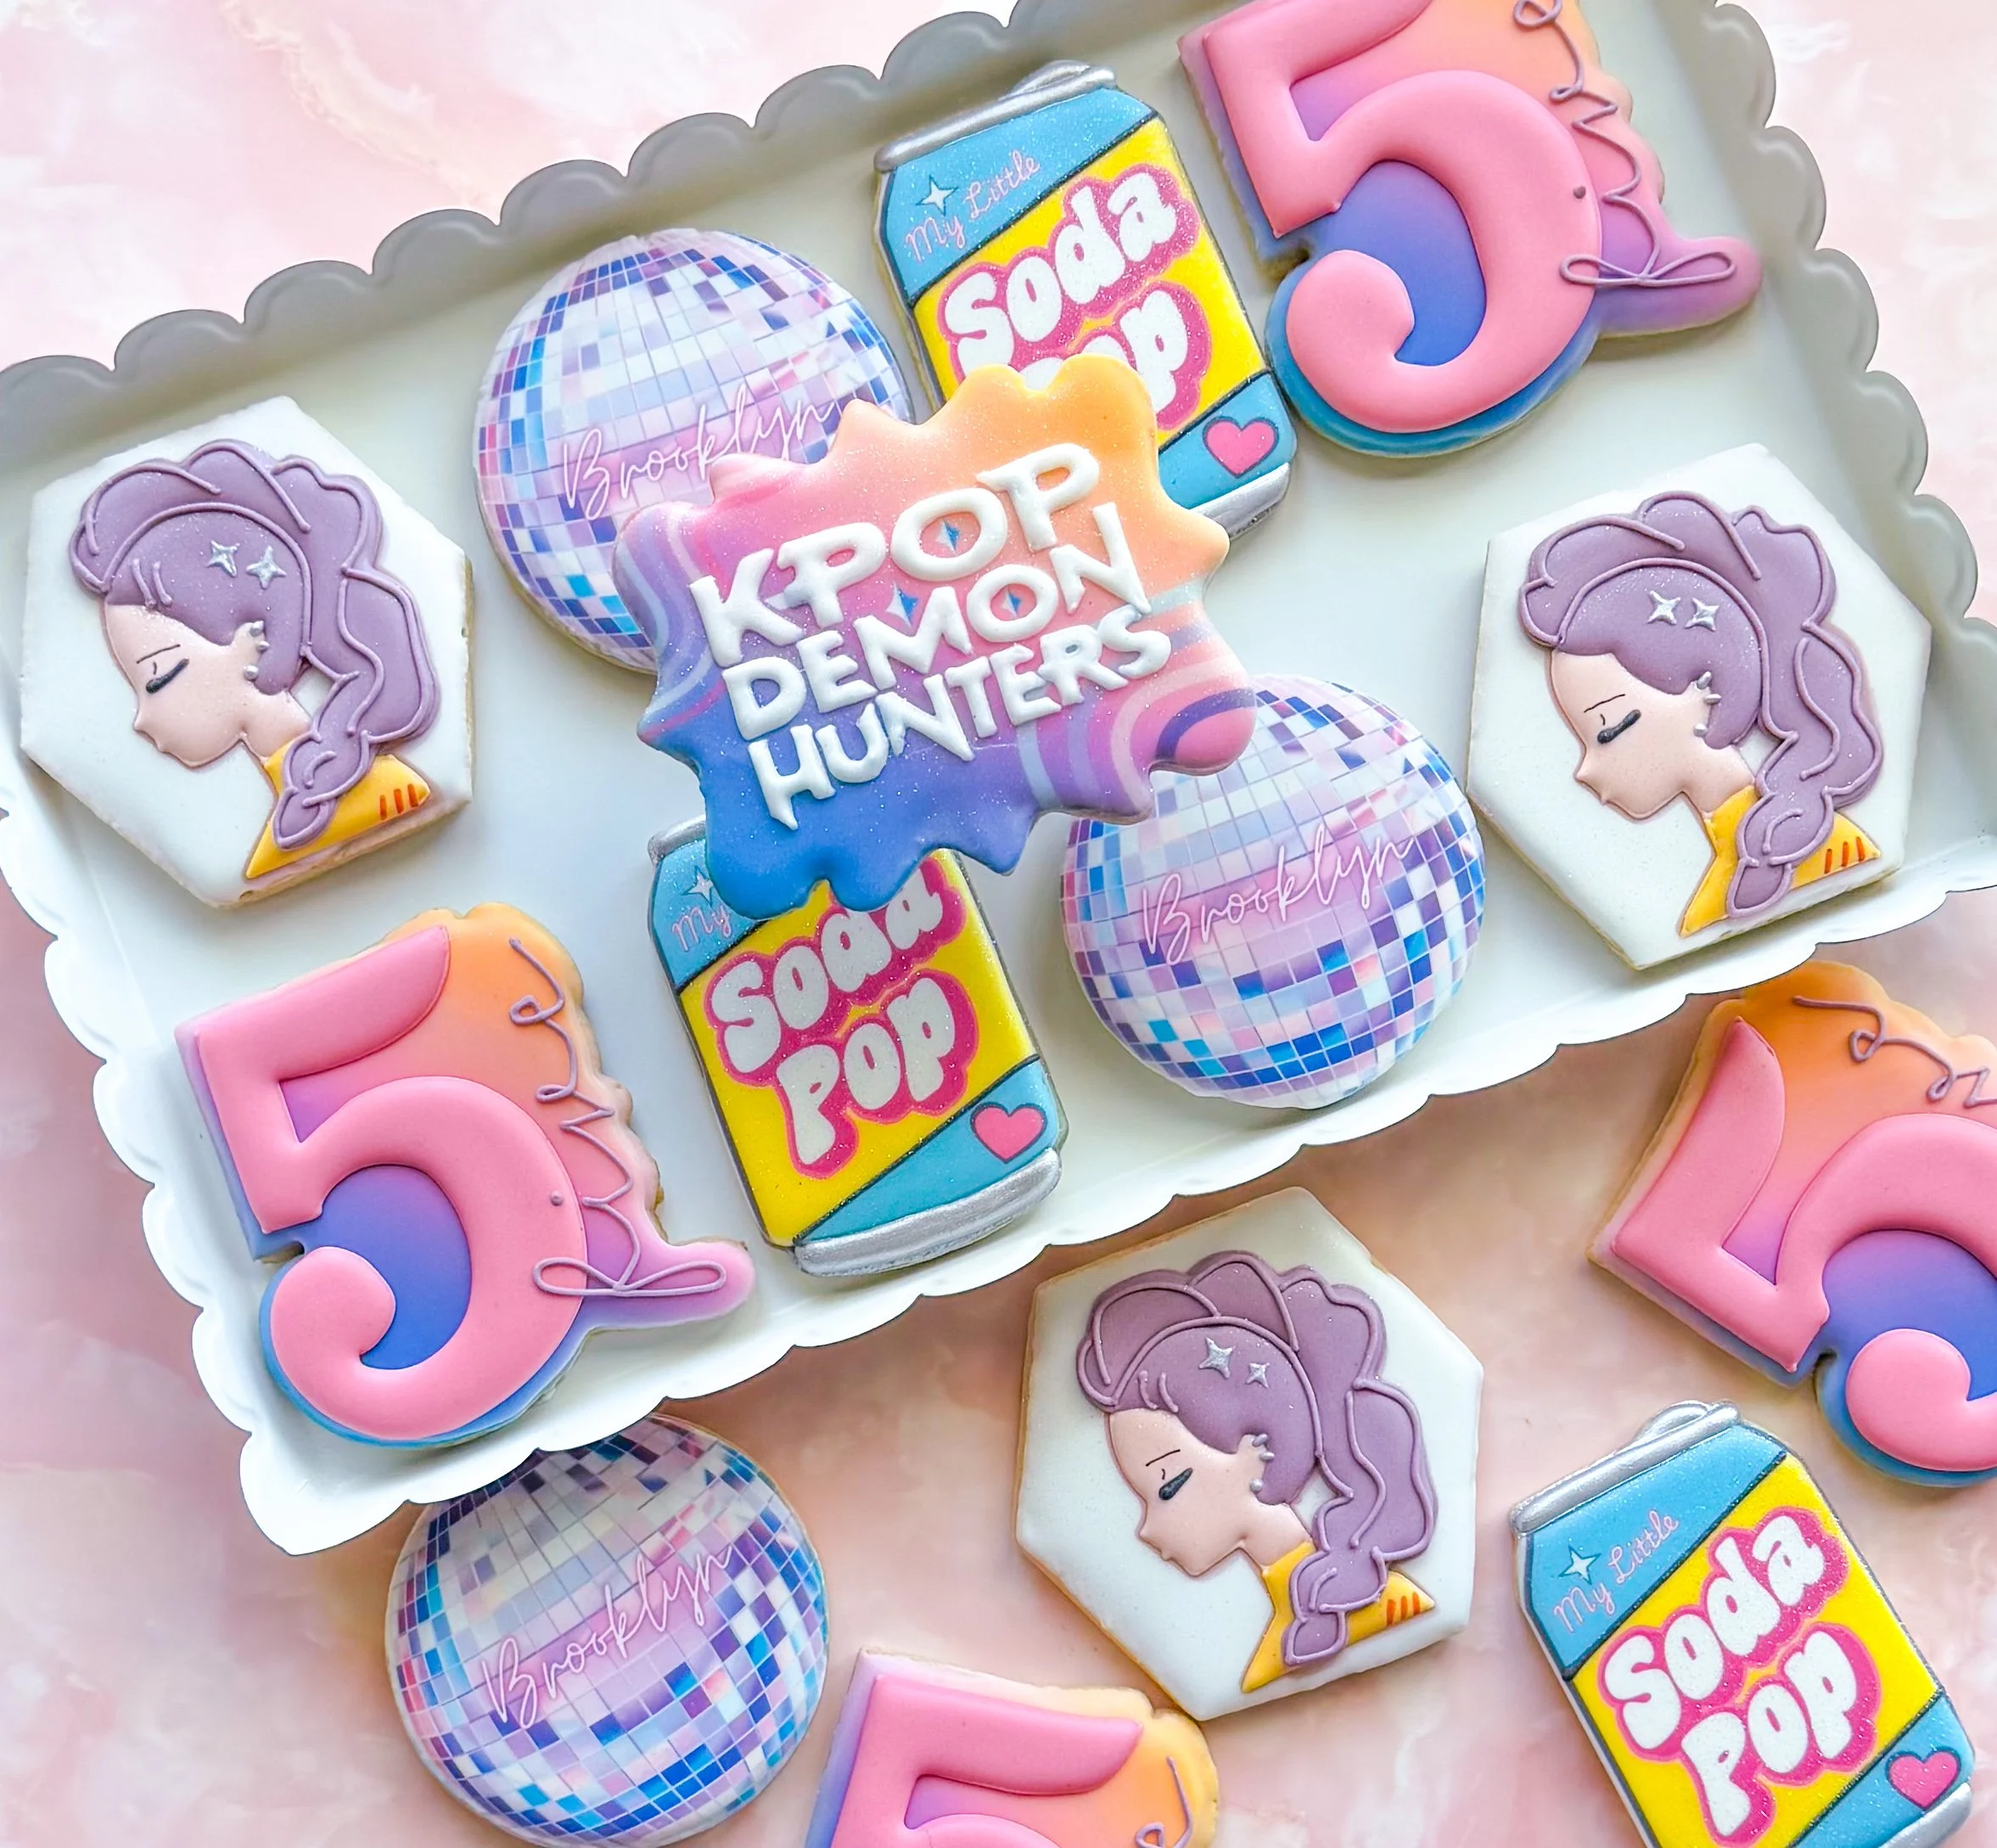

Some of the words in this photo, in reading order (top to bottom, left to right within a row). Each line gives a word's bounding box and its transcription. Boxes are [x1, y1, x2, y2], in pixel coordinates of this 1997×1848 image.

[906, 216, 965, 262] My
[963, 150, 1040, 219] Little
[945, 171, 1176, 377] Soda
[1203, 0, 1602, 434] 5
[563, 383, 836, 521] Brooklyn
[690, 443, 1101, 667] KPOP
[721, 503, 1151, 740] DEMON
[748, 609, 1171, 830] HUNTERS
[671, 905, 732, 952] My
[1142, 823, 1415, 966] Brooklyn
[196, 925, 588, 1440] 5
[1612, 1015, 1997, 1472] 5
[482, 1546, 733, 1729] Brooklyn
[1553, 1581, 1616, 1633] My
[1607, 1510, 1680, 1585] Little
[1604, 1515, 1825, 1750] Soda
